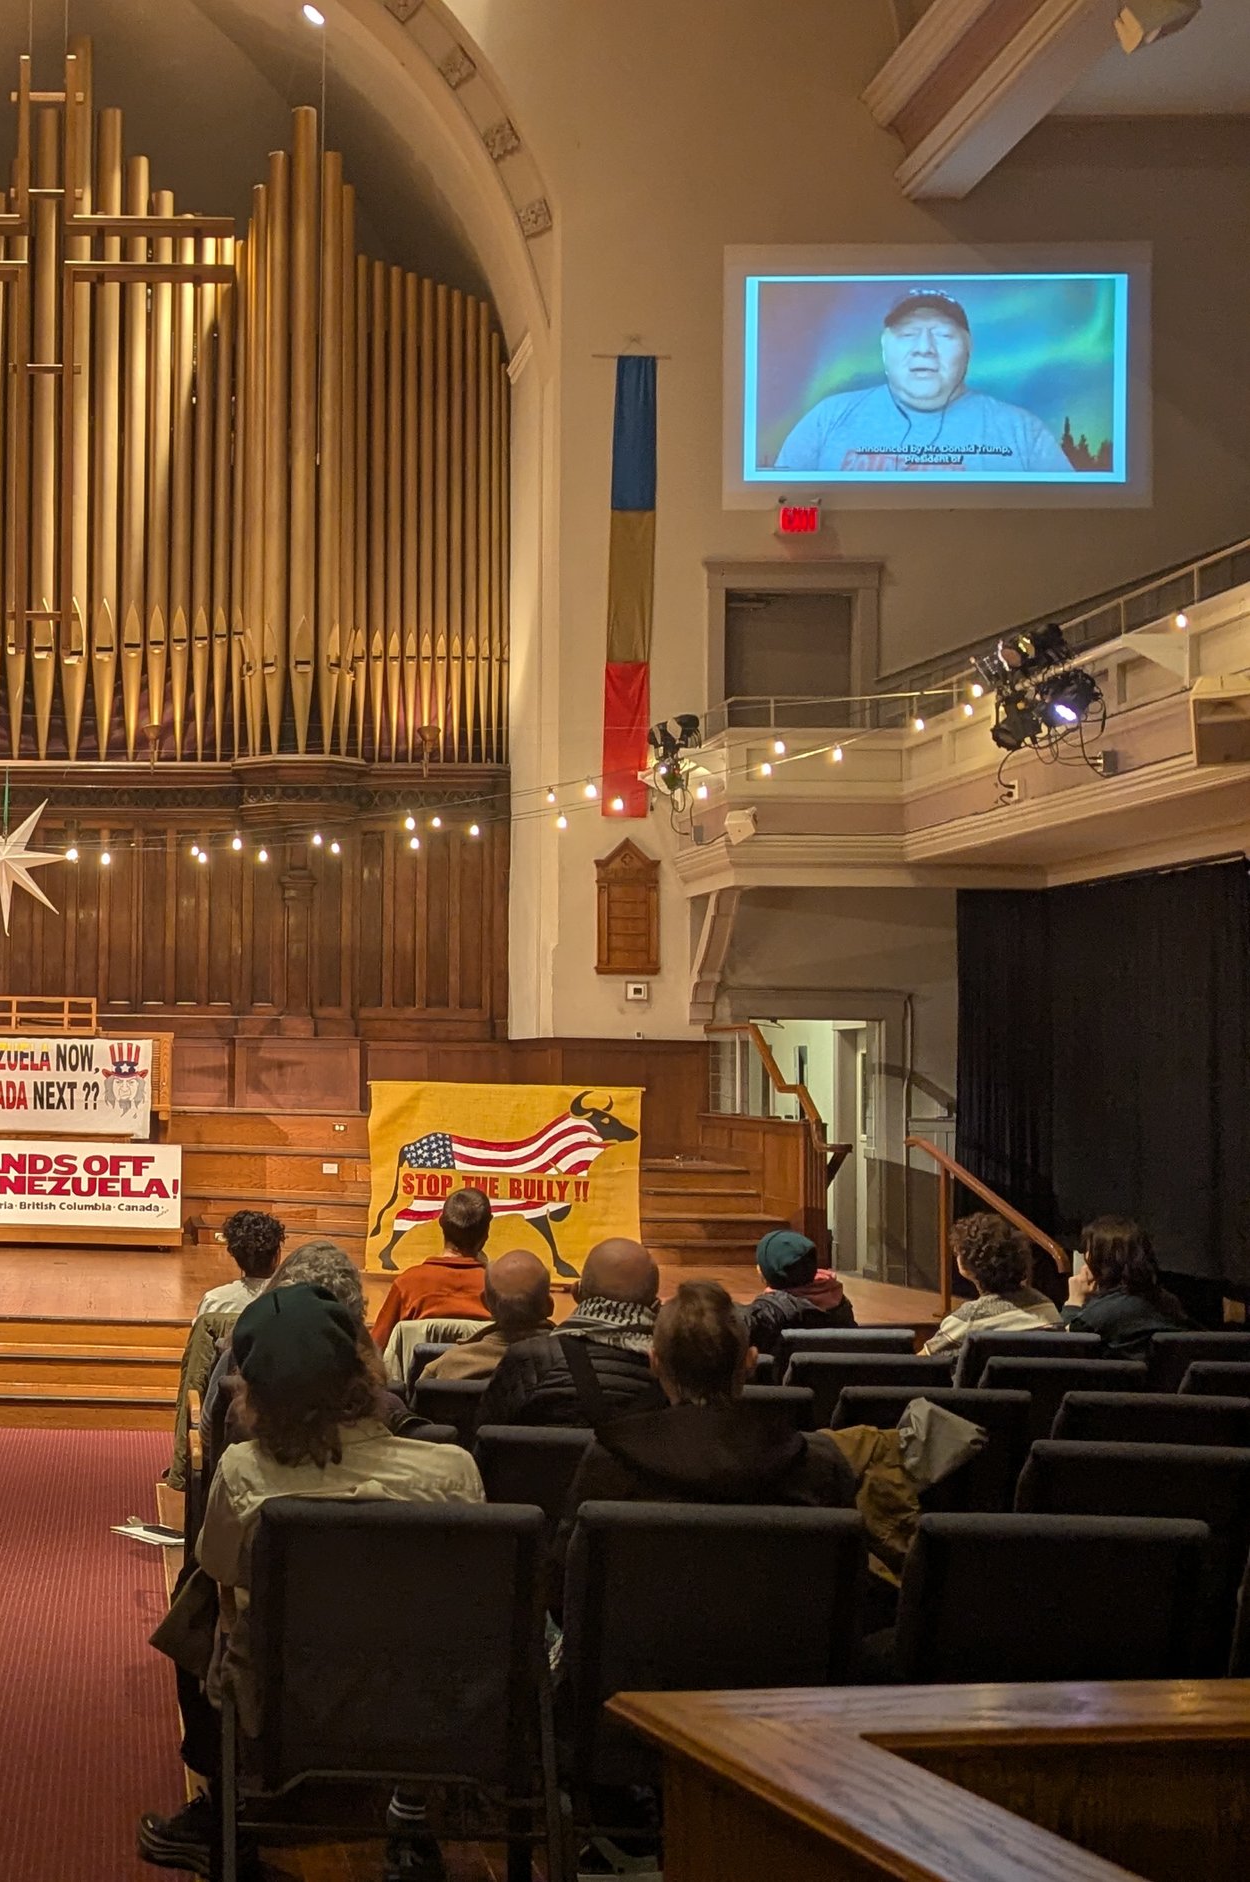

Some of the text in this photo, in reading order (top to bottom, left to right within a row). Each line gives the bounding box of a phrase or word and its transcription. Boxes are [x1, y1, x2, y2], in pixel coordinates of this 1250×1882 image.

[942, 445, 975, 454] Donald
[55, 1043, 100, 1075] NOW,
[33, 1081, 78, 1111] NEXT
[82, 1081, 100, 1111] ??
[83, 1155, 155, 1177] OFF
[402, 1173, 453, 1196] STOP
[462, 1175, 500, 1199] THE
[509, 1178, 570, 1202] BULLY
[18, 1201, 56, 1211] British
[58, 1202, 112, 1212] Columbia
[117, 1202, 160, 1213] Canada
